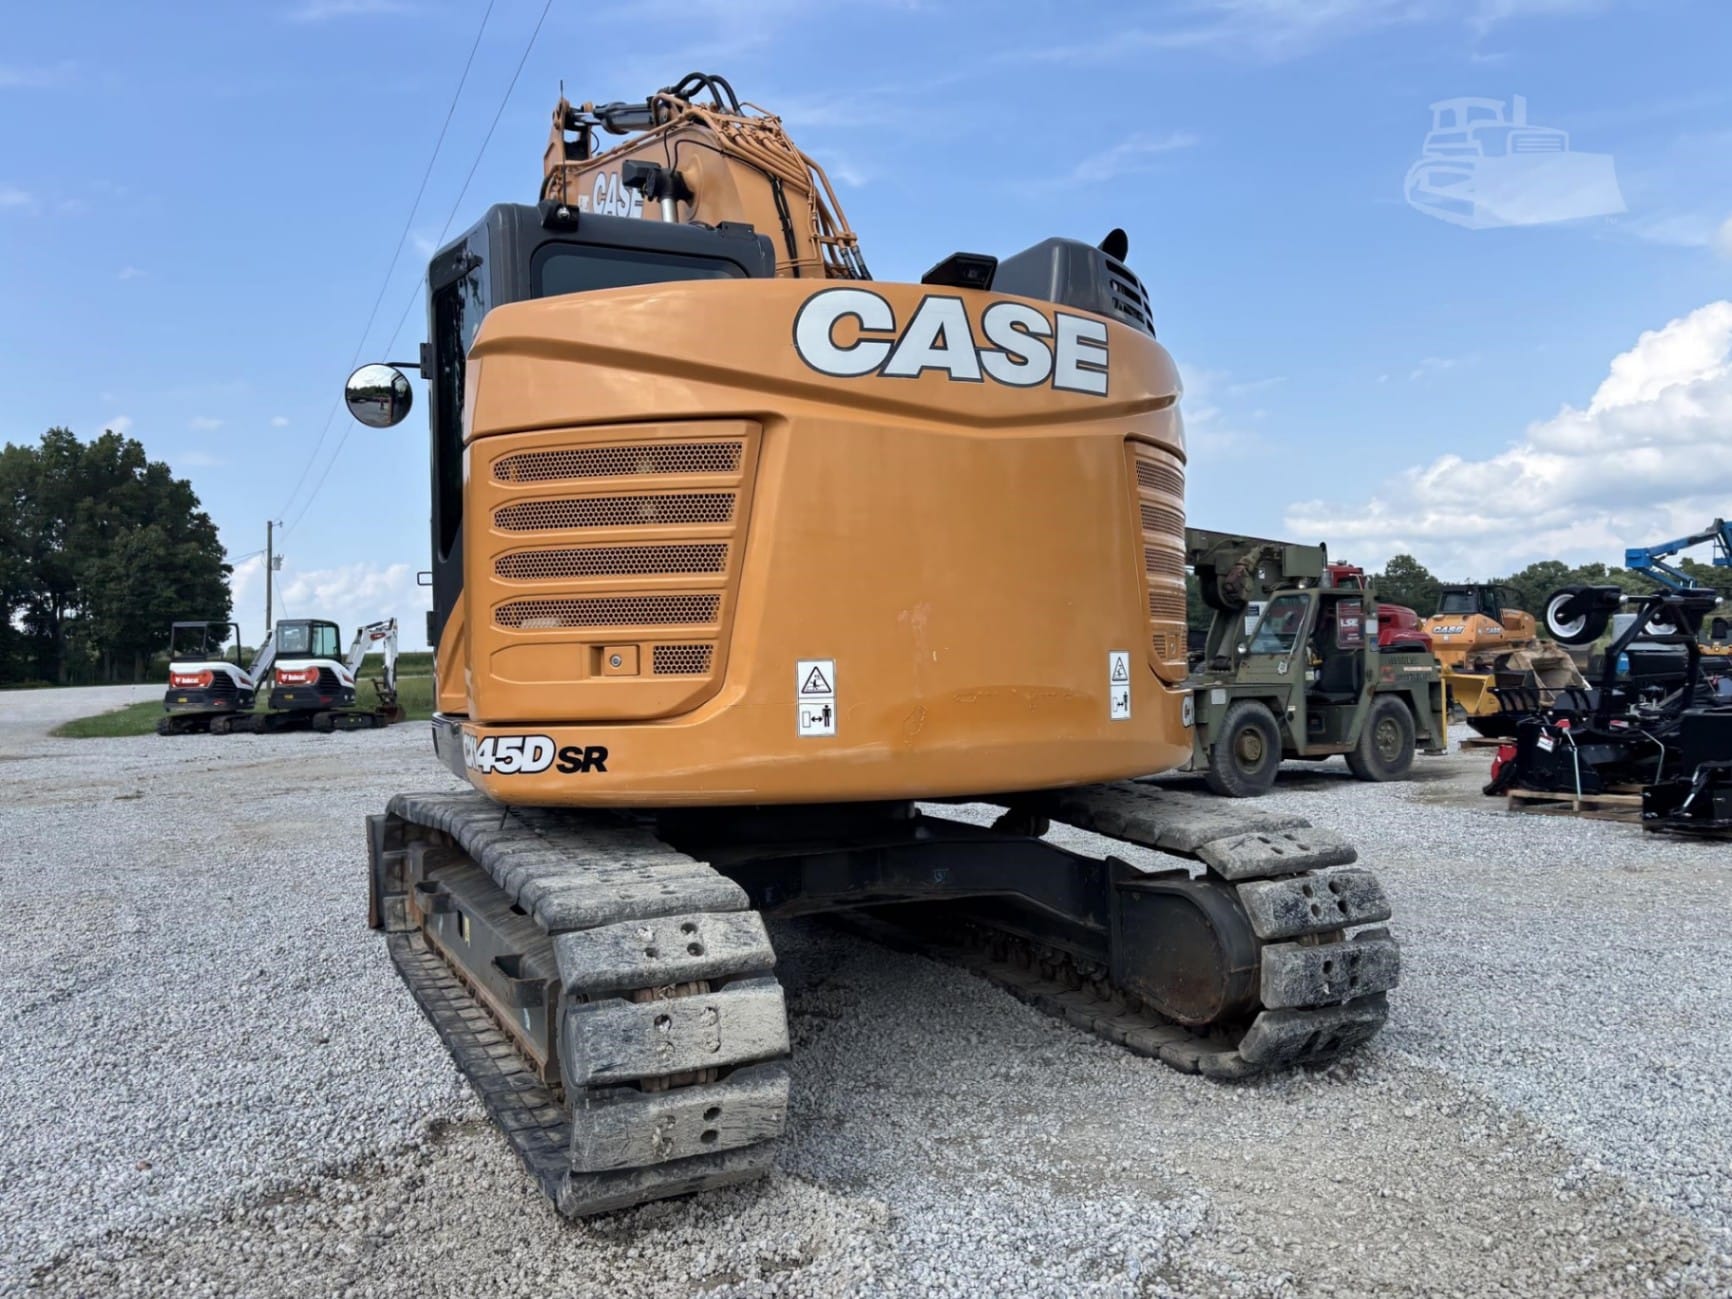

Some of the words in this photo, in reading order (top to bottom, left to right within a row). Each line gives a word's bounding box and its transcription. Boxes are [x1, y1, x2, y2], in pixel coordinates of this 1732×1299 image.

[793, 287, 1108, 397] CASE
[1432, 626, 1465, 634] CASE
[556, 746, 608, 774] SR
